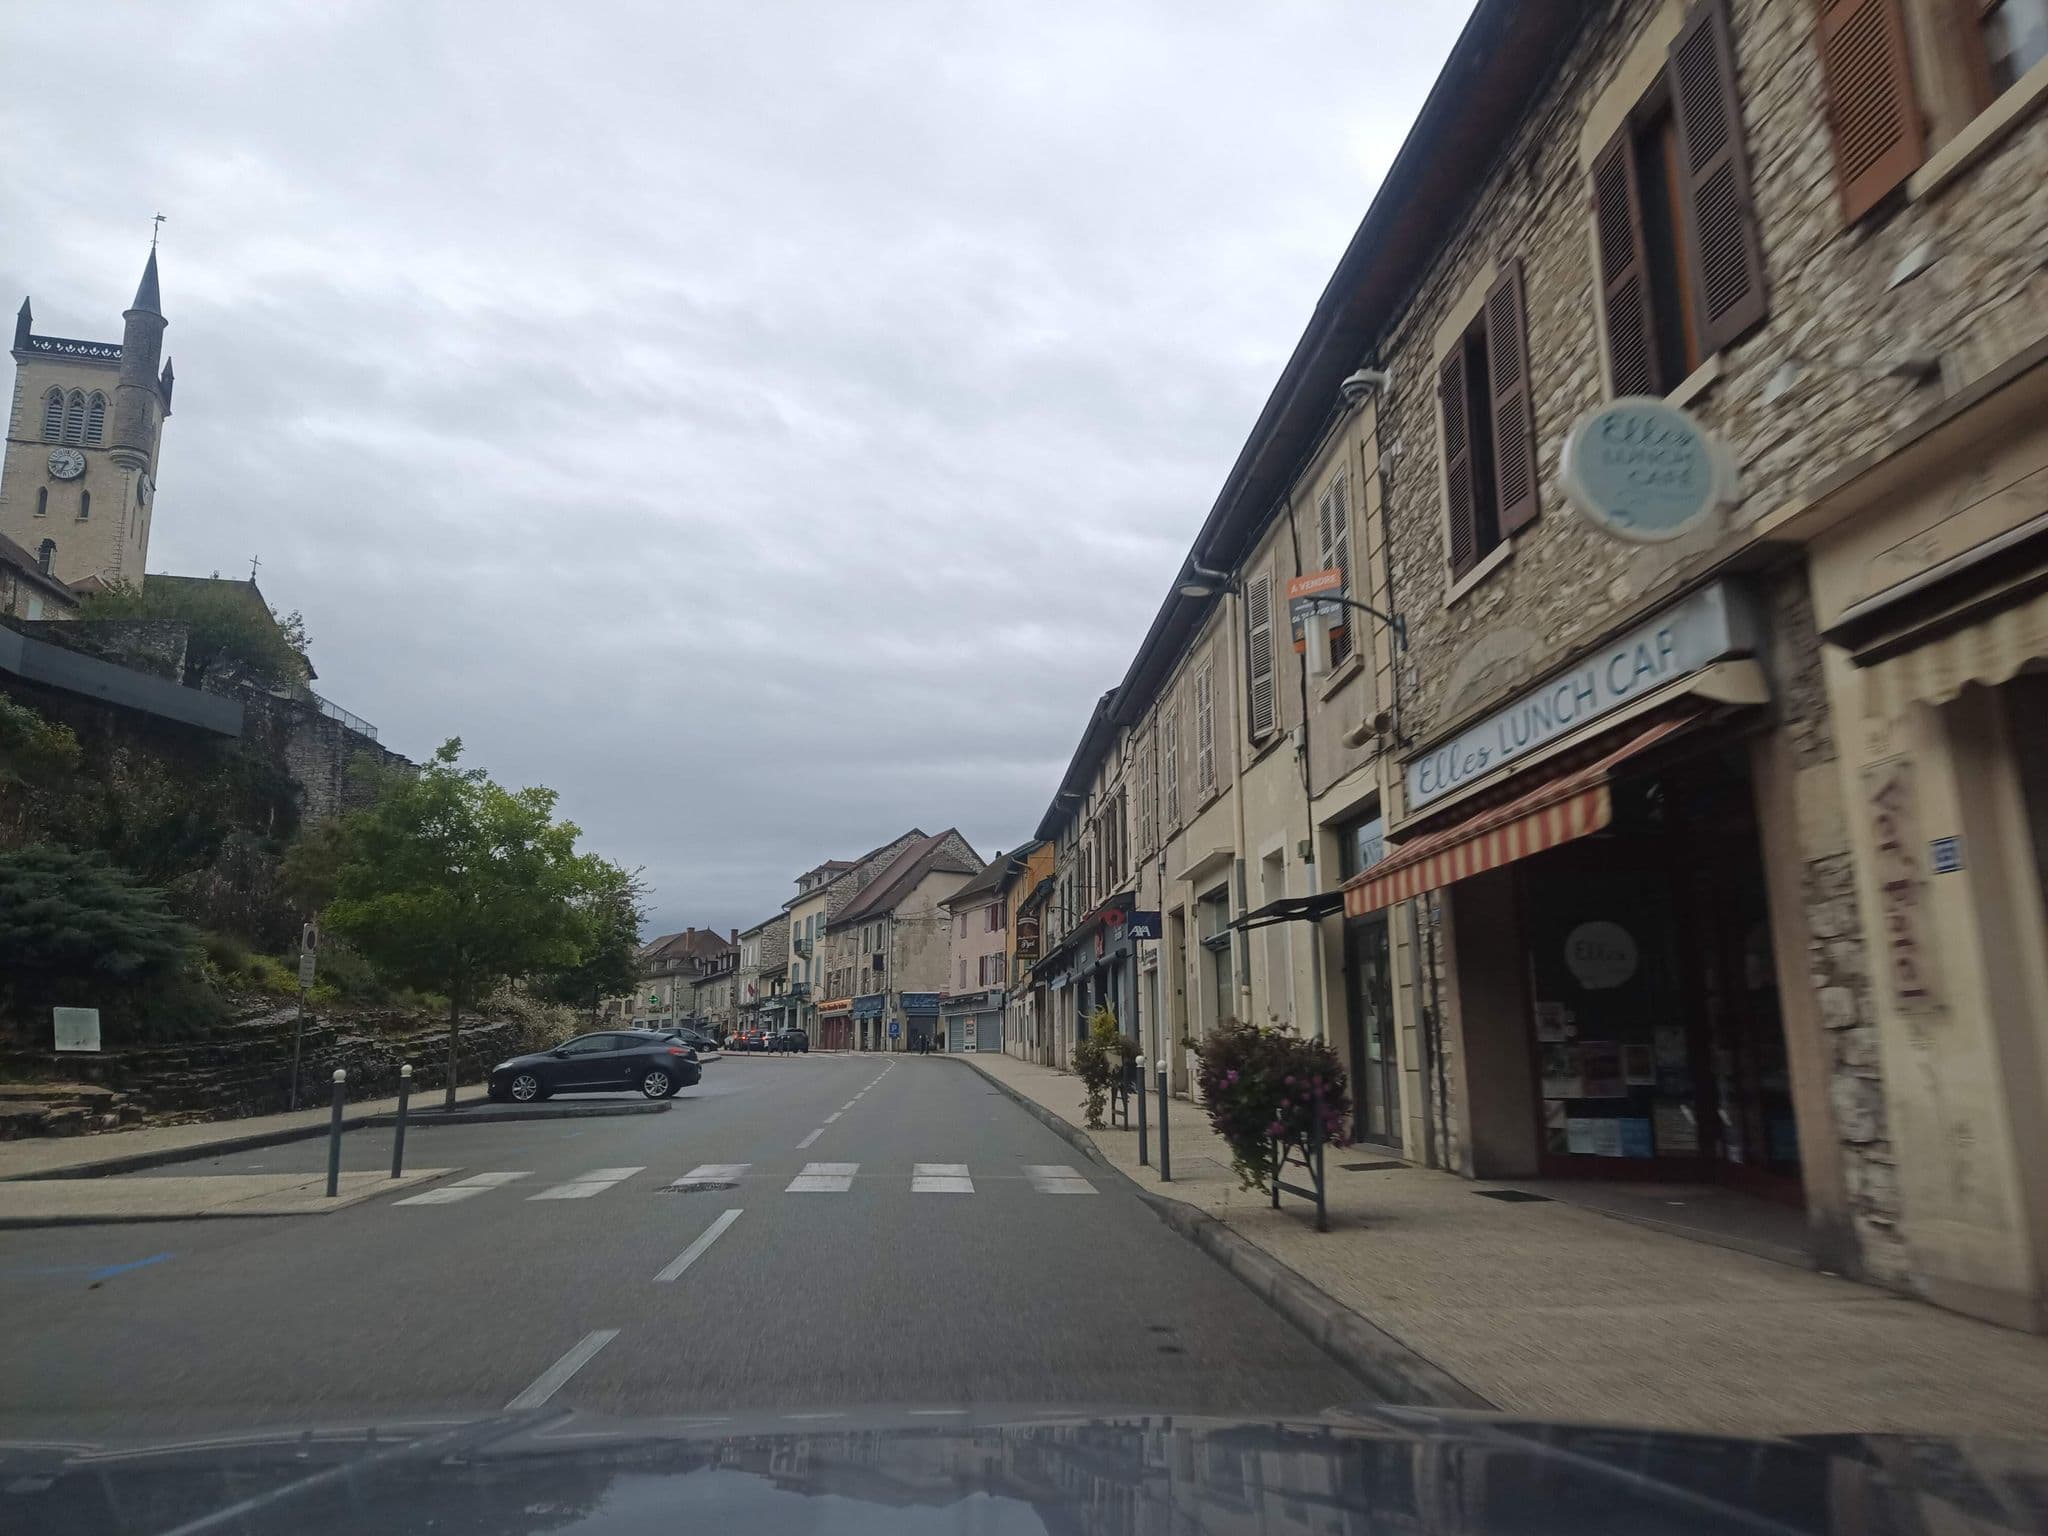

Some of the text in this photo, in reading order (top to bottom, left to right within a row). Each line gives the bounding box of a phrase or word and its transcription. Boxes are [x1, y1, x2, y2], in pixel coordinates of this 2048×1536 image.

[1418, 746, 1493, 795] Elles
[1498, 670, 1599, 755] LUNCH
[1128, 925, 1151, 937] AXA
